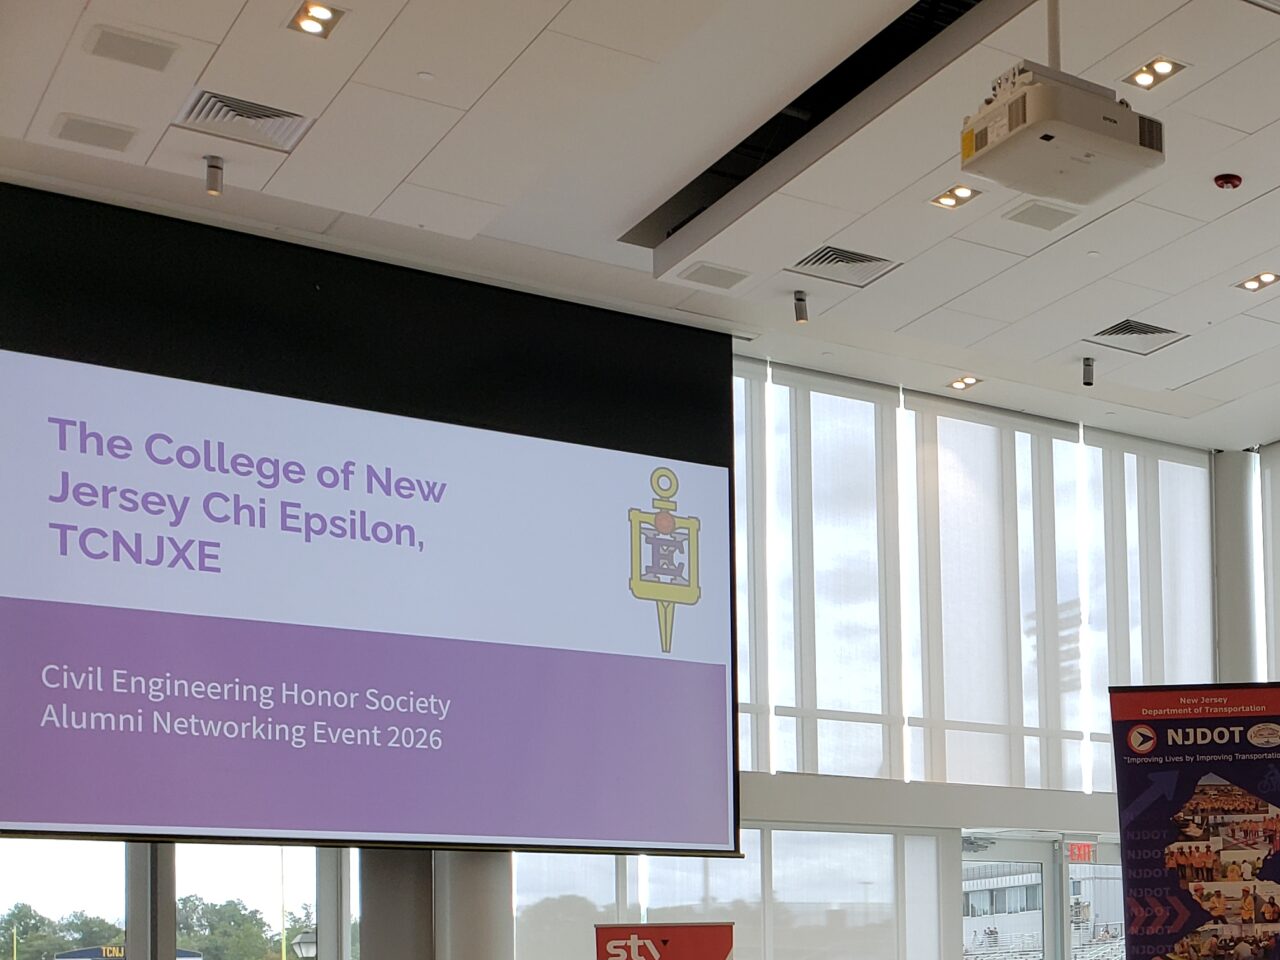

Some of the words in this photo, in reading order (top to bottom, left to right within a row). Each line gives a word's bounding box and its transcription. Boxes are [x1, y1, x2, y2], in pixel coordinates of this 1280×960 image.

[48, 416, 133, 460] The
[144, 432, 306, 489] College
[316, 460, 356, 491] of
[366, 463, 447, 503] New
[48, 471, 190, 527] Jersey
[202, 491, 266, 529] Chi
[280, 500, 424, 552] Epsilon,
[48, 522, 221, 573] TCNJXE
[41, 664, 103, 692] Civil
[112, 669, 274, 709] Engineering
[281, 682, 359, 709] Honor
[365, 688, 451, 720] Society
[1200, 696, 1228, 705] Jersey
[1142, 707, 1192, 716] Department
[1193, 706, 1203, 714] of
[1204, 704, 1266, 715] Transportation
[40, 703, 143, 732] Alumni
[153, 710, 306, 748] Networking
[313, 721, 382, 746] Event
[387, 726, 442, 750] 2026
[1167, 727, 1243, 746] NJDOT
[1165, 755, 1184, 763] Lives
[1185, 755, 1194, 763] by
[1196, 753, 1233, 763] Improving
[1070, 844, 1091, 861] EXIT
[1127, 849, 1162, 859] NJDO
[102, 946, 125, 957] TCNJ
